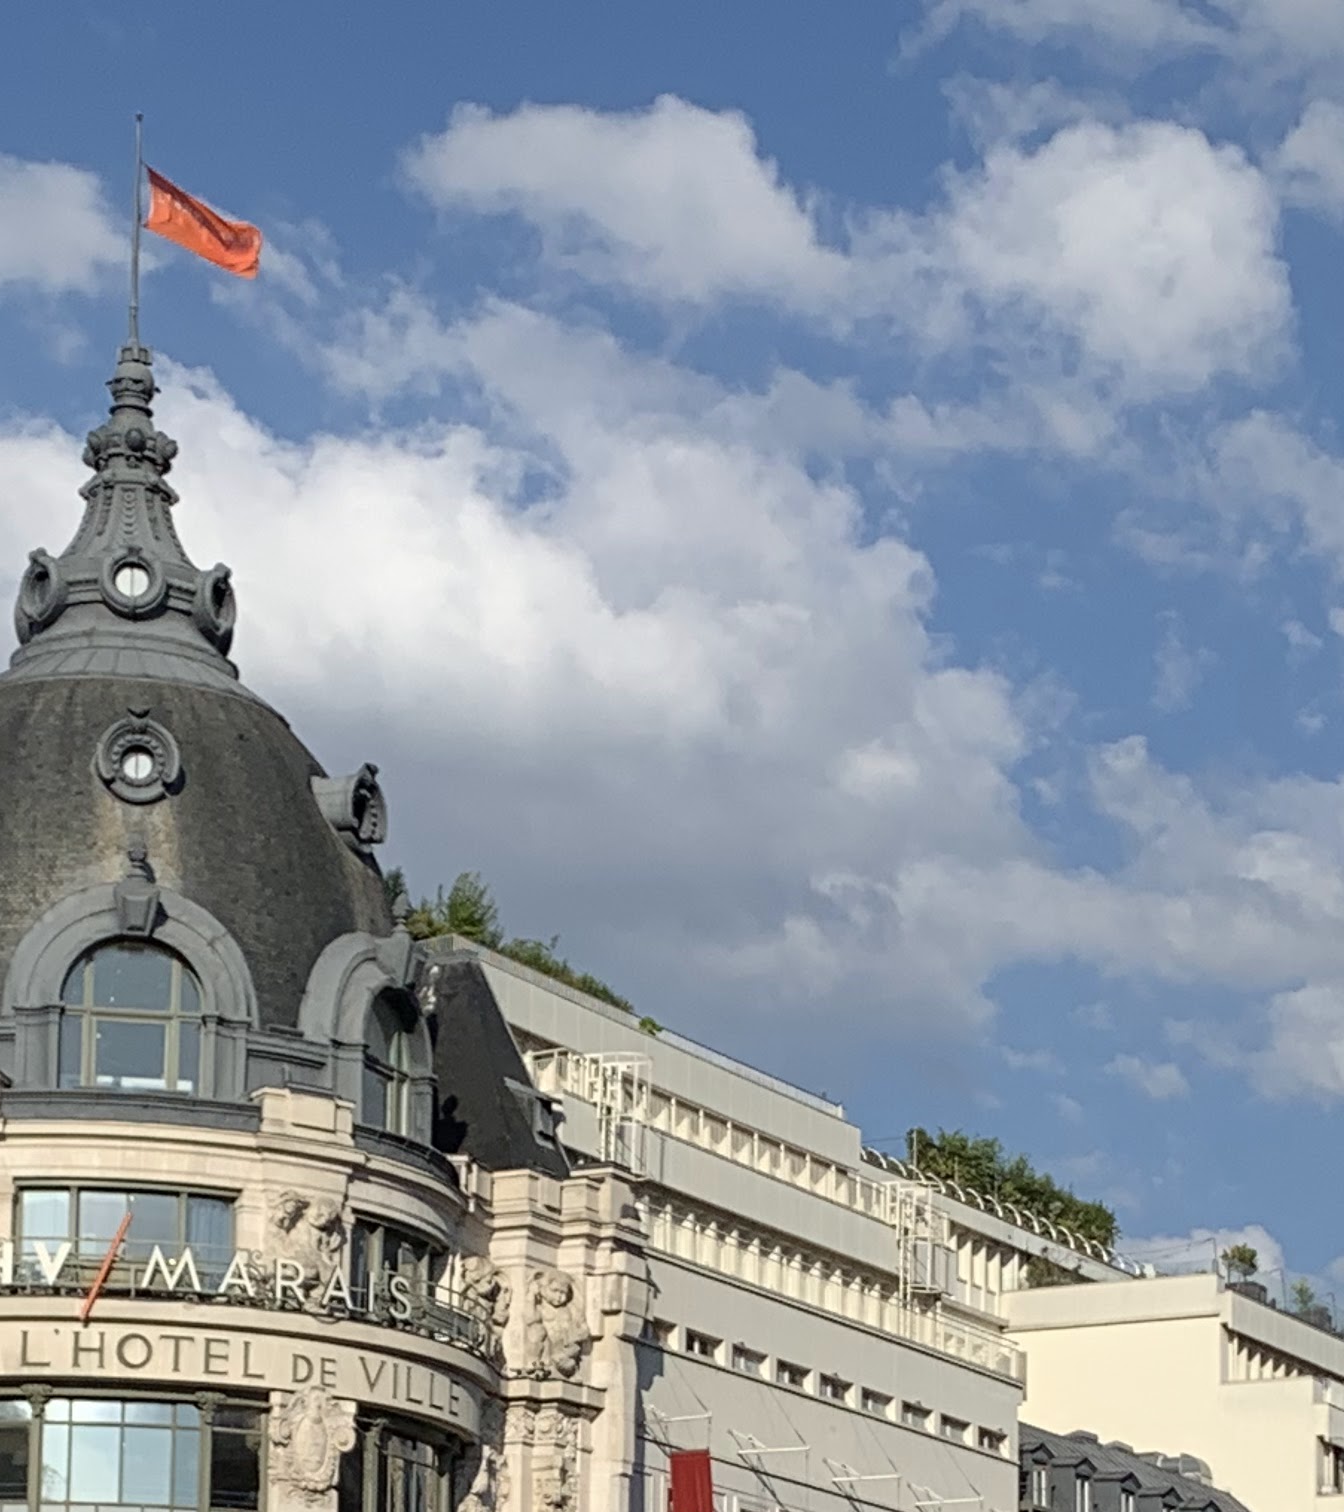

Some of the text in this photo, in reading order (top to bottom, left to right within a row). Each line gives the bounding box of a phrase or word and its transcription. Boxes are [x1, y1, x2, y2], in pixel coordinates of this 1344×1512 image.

[140, 1244, 413, 1321] MARAIS
[291, 1352, 338, 1389] DE
[358, 1355, 463, 1418] VILLE
